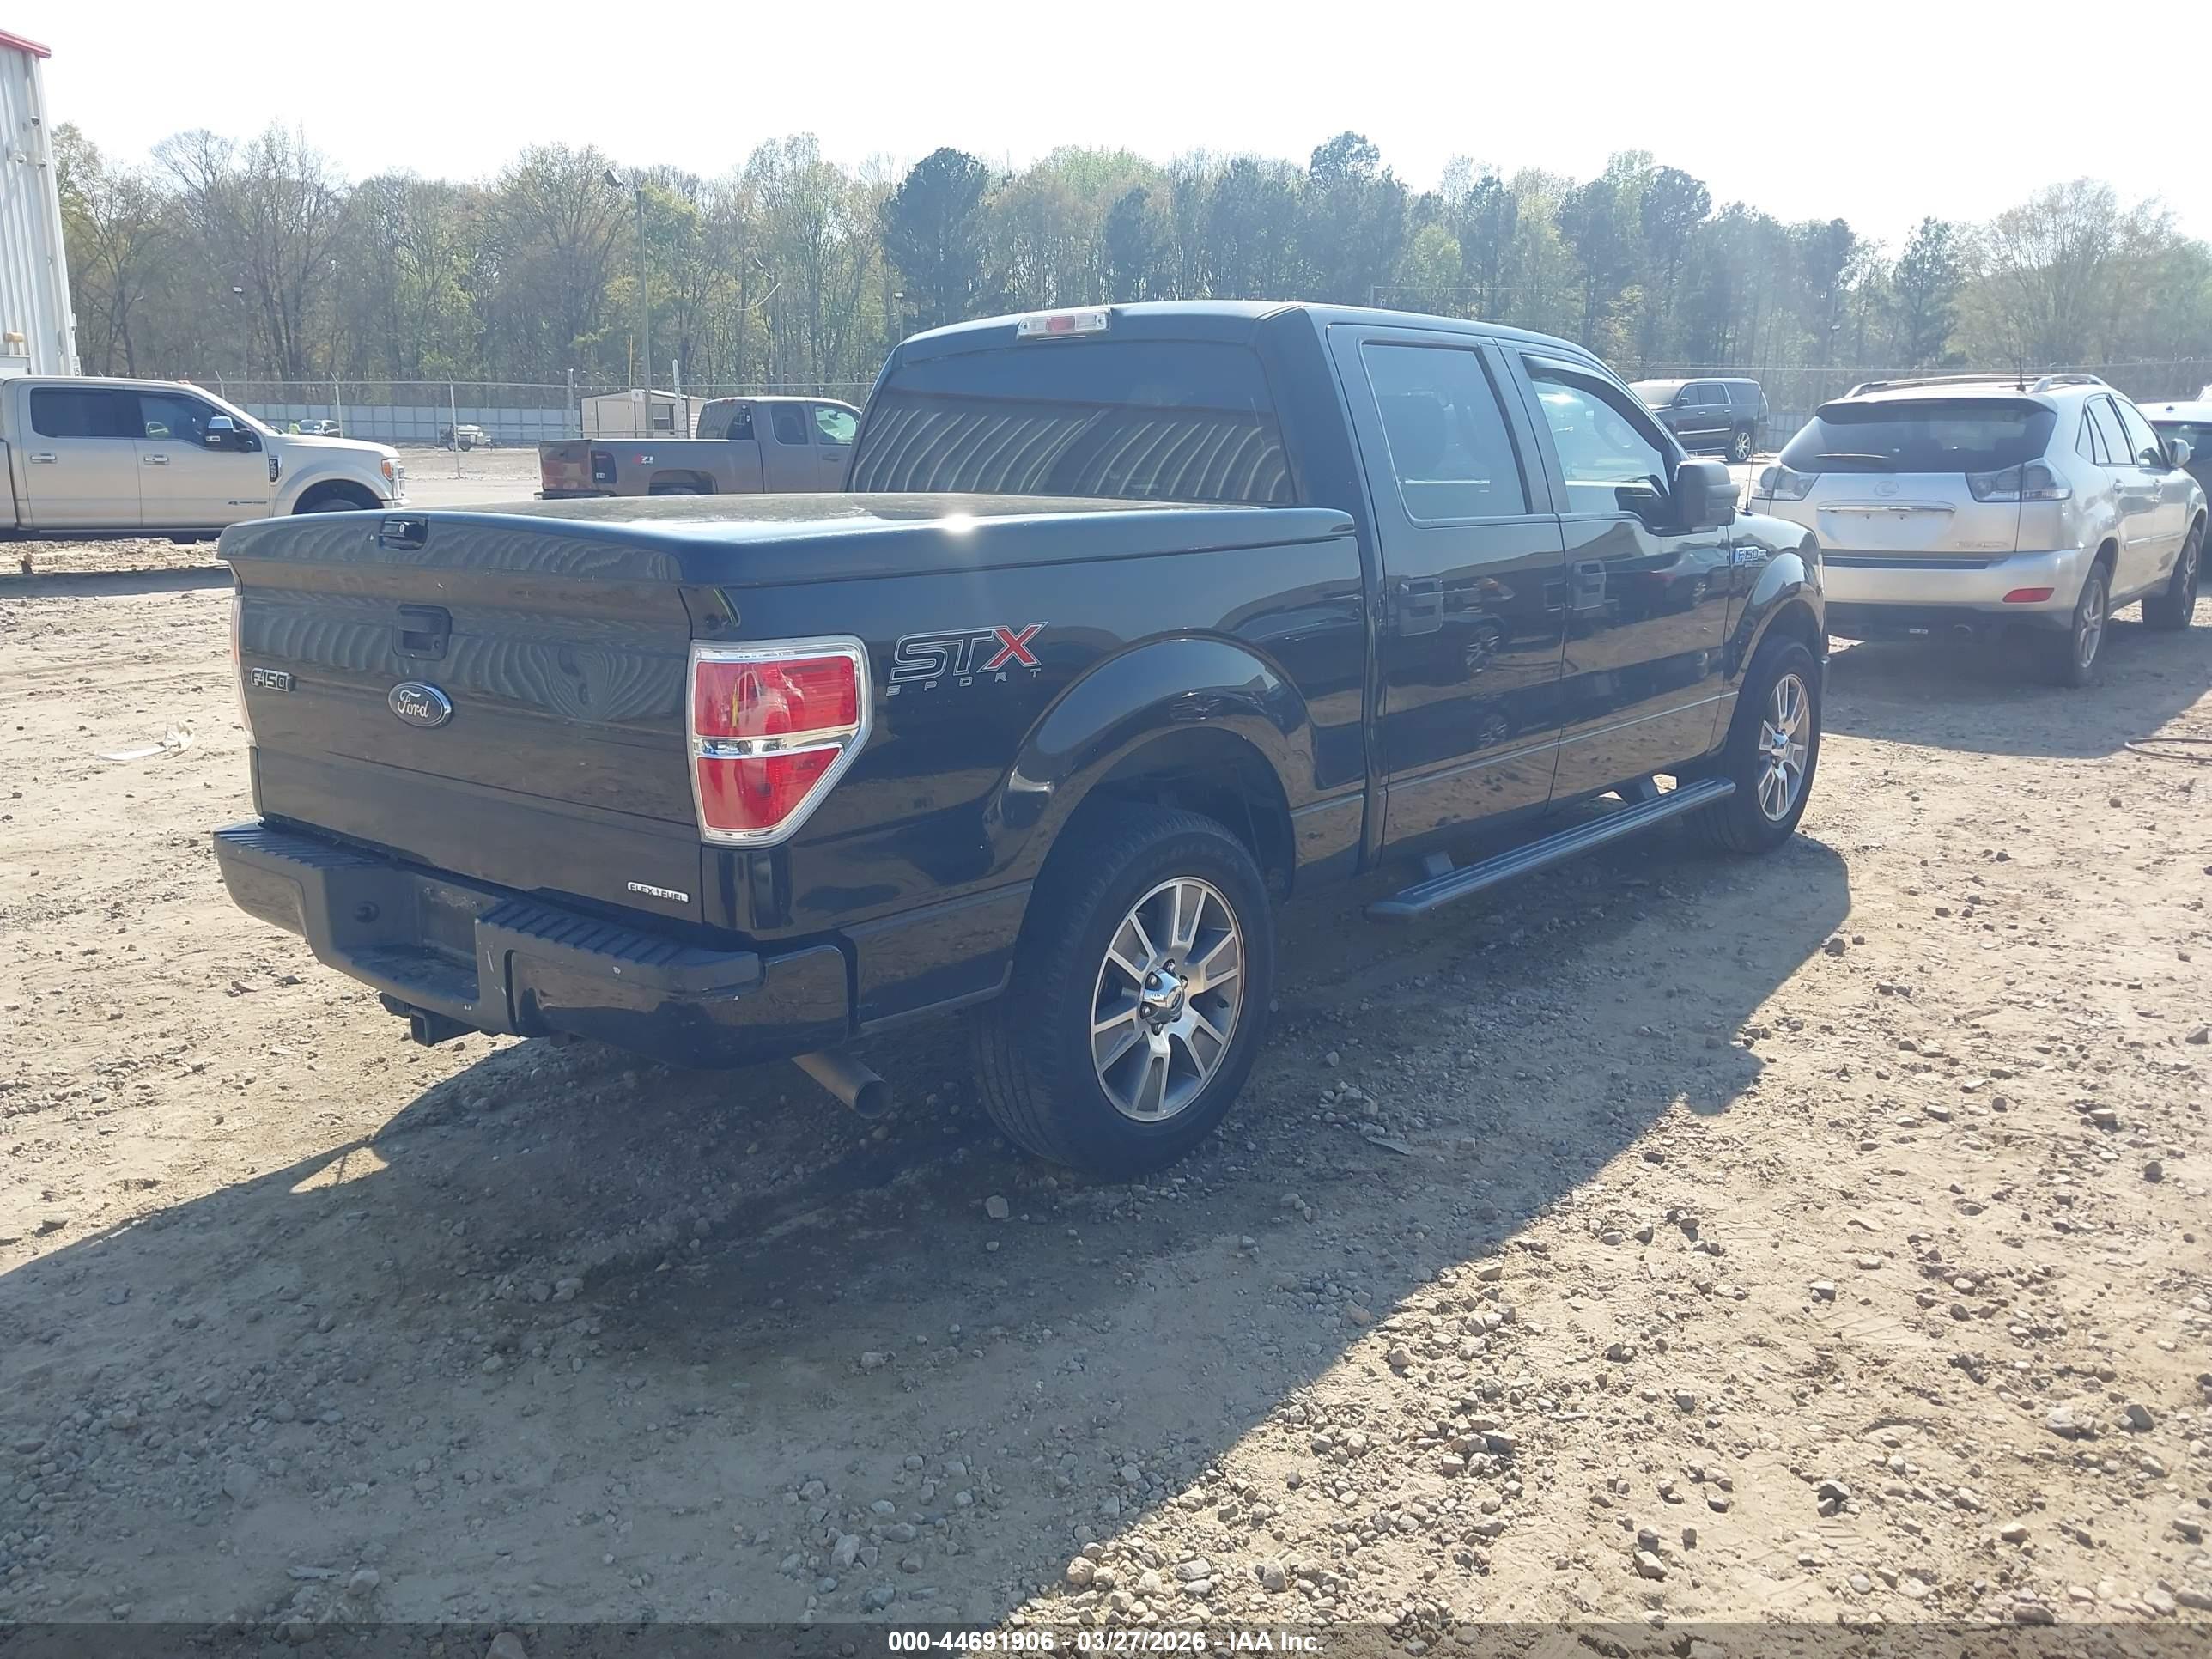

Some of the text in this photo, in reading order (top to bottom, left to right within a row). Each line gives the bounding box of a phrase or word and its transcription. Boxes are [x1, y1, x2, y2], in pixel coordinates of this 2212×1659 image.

[889, 621, 1049, 684] STX
[885, 667, 1042, 696] SPORT
[398, 690, 429, 718] Ford
[629, 883, 687, 902] FLEX FUEL
